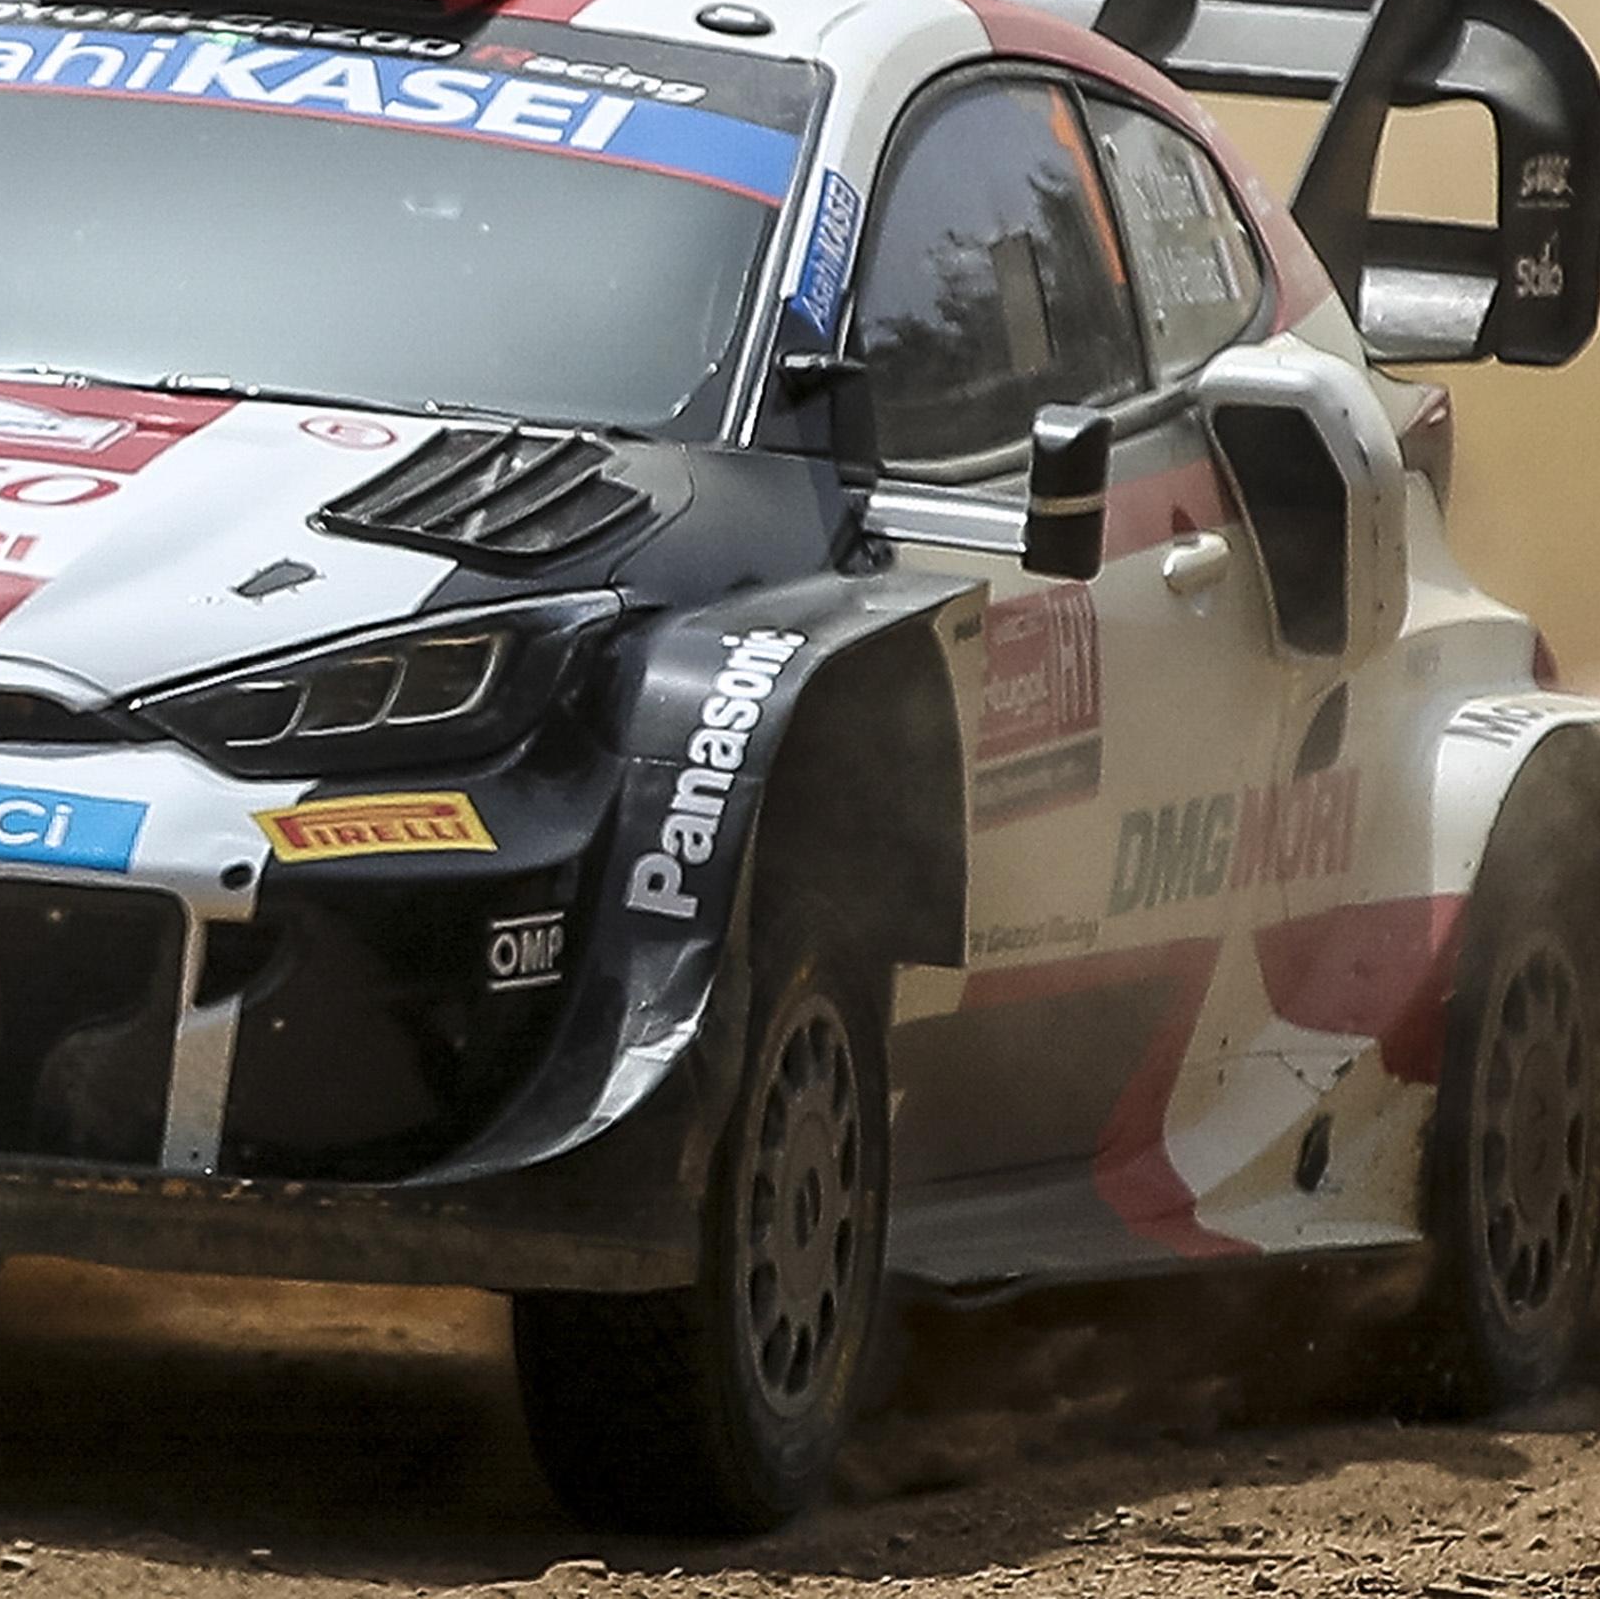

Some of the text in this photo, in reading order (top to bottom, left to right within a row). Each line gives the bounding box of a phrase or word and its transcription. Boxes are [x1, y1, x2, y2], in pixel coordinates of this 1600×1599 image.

[471, 45, 708, 104] Racing
[626, 629, 806, 919] Panasonic
[274, 804, 471, 849] PIRELLI
[490, 925, 565, 977] OMP
